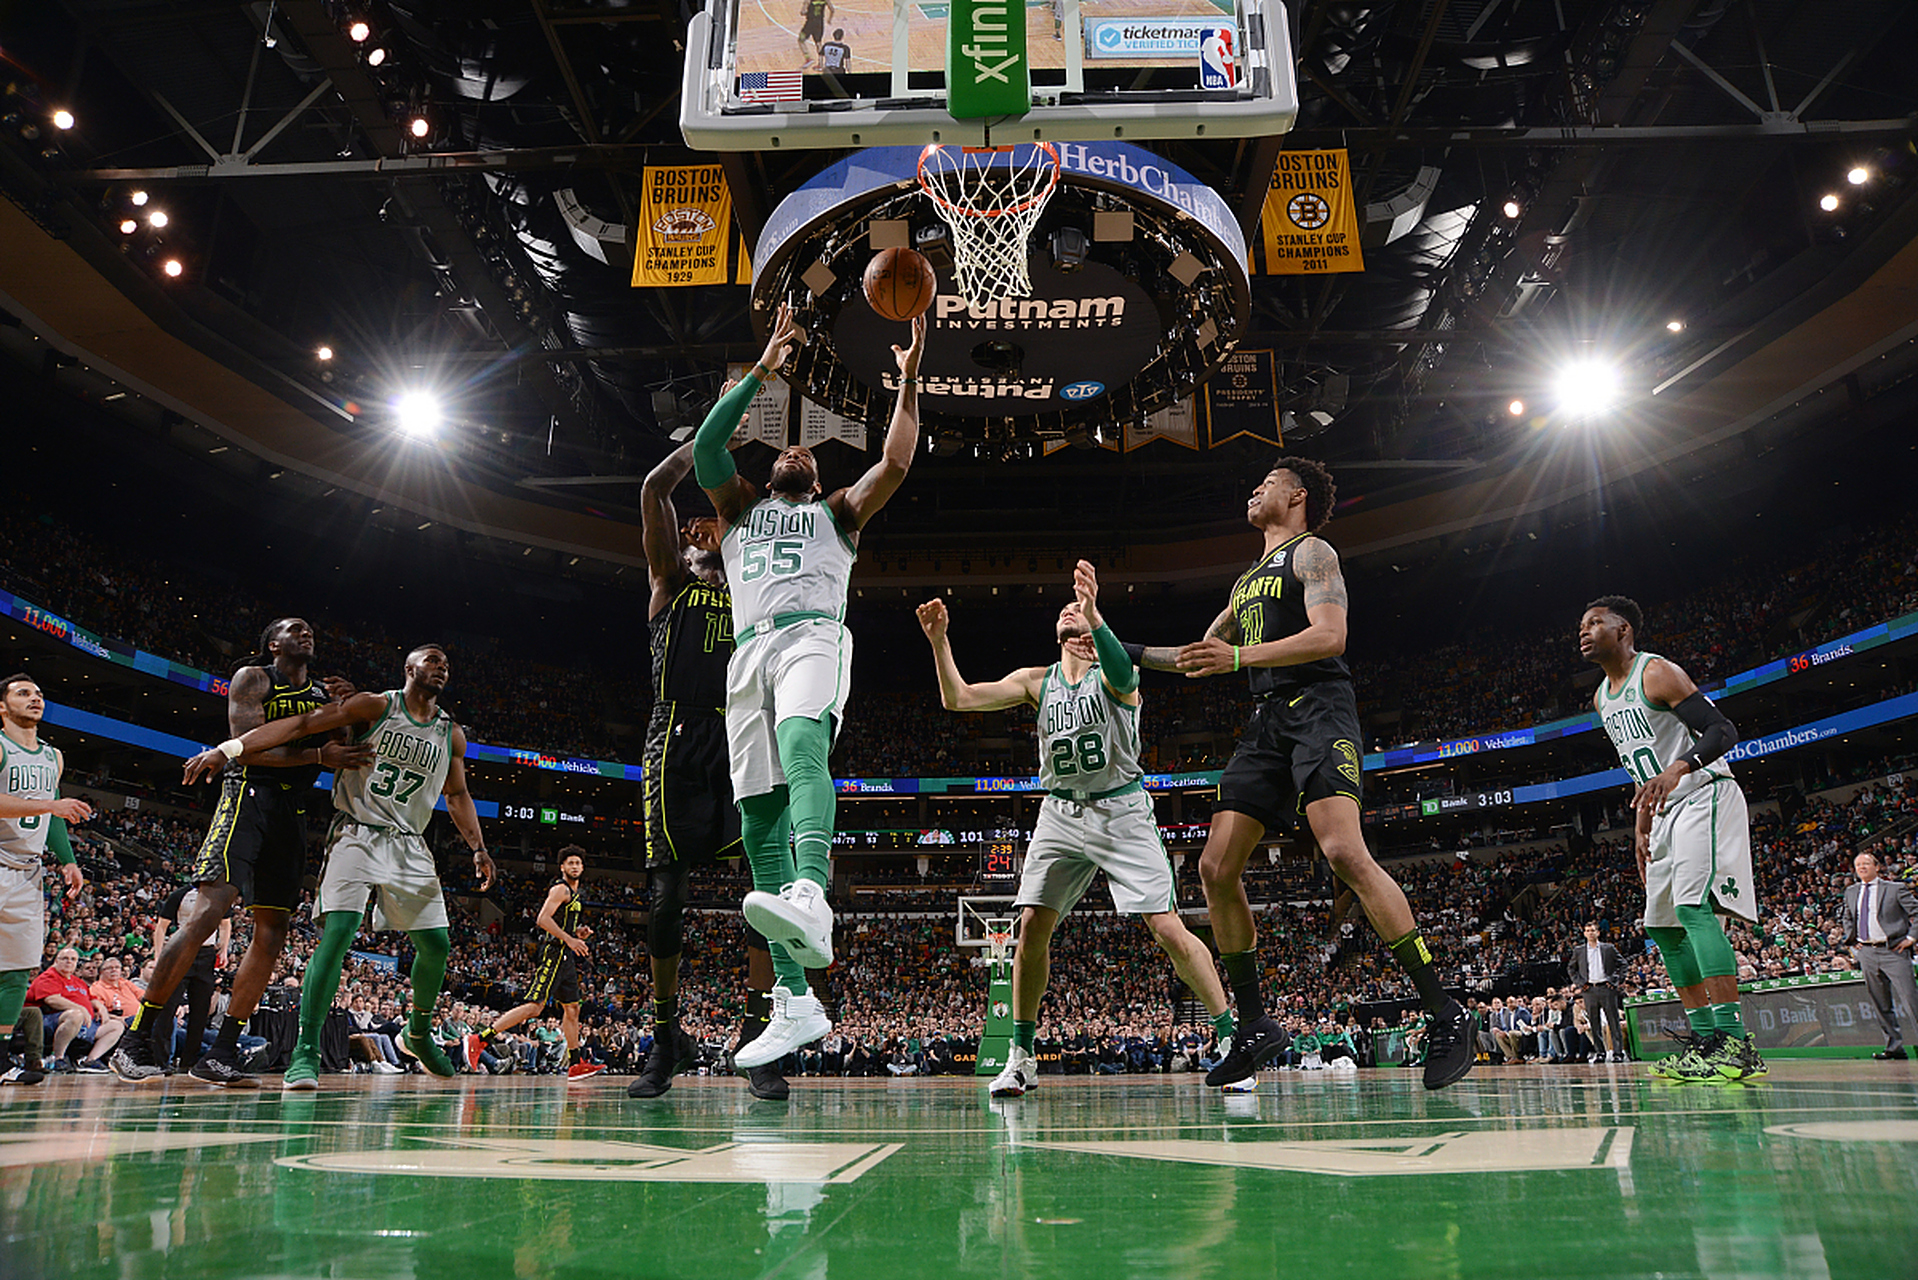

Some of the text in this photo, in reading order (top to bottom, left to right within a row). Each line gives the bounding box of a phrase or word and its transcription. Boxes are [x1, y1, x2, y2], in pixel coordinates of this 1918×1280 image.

[962, 0, 1019, 84] xfin
[1124, 40, 1174, 49] VERIFIED
[1205, 74, 1224, 86] NBA
[1275, 154, 1338, 172] OSTON
[654, 168, 722, 186] BOSTON
[1270, 171, 1339, 190] BRUINS
[652, 185, 721, 204] BRUINS
[1277, 233, 1347, 246] STANLEY CUP
[648, 245, 716, 258] STANLEY CUP
[1277, 245, 1350, 258] CHAMPIONS
[645, 257, 716, 270] CHAMPIONS
[1302, 260, 1328, 270] 2011
[668, 271, 693, 282] 1929
[935, 294, 1126, 319] Putnam
[935, 318, 1123, 330] INVESTMENTS
[740, 509, 815, 543] BOSTON
[740, 541, 804, 583] 55
[23, 606, 68, 639] 11,000
[1790, 654, 1809, 673] 36
[211, 678, 230, 697] 56
[1048, 693, 1106, 736] BOSTON
[376, 730, 442, 774] BOSTON
[1050, 732, 1108, 777] 28
[1436, 739, 1480, 758] 11,000
[515, 752, 557, 769] 11,000
[370, 761, 426, 805] 37
[841, 780, 858, 792] 36
[974, 778, 1015, 791] 11,000
[1143, 776, 1160, 788] 56
[1478, 790, 1512, 807] 3:03
[504, 805, 535, 820] 3:03
[960, 831, 984, 843] 101
[987, 854, 1010, 872] 24
[1755, 1005, 1819, 1031] TD Bank
